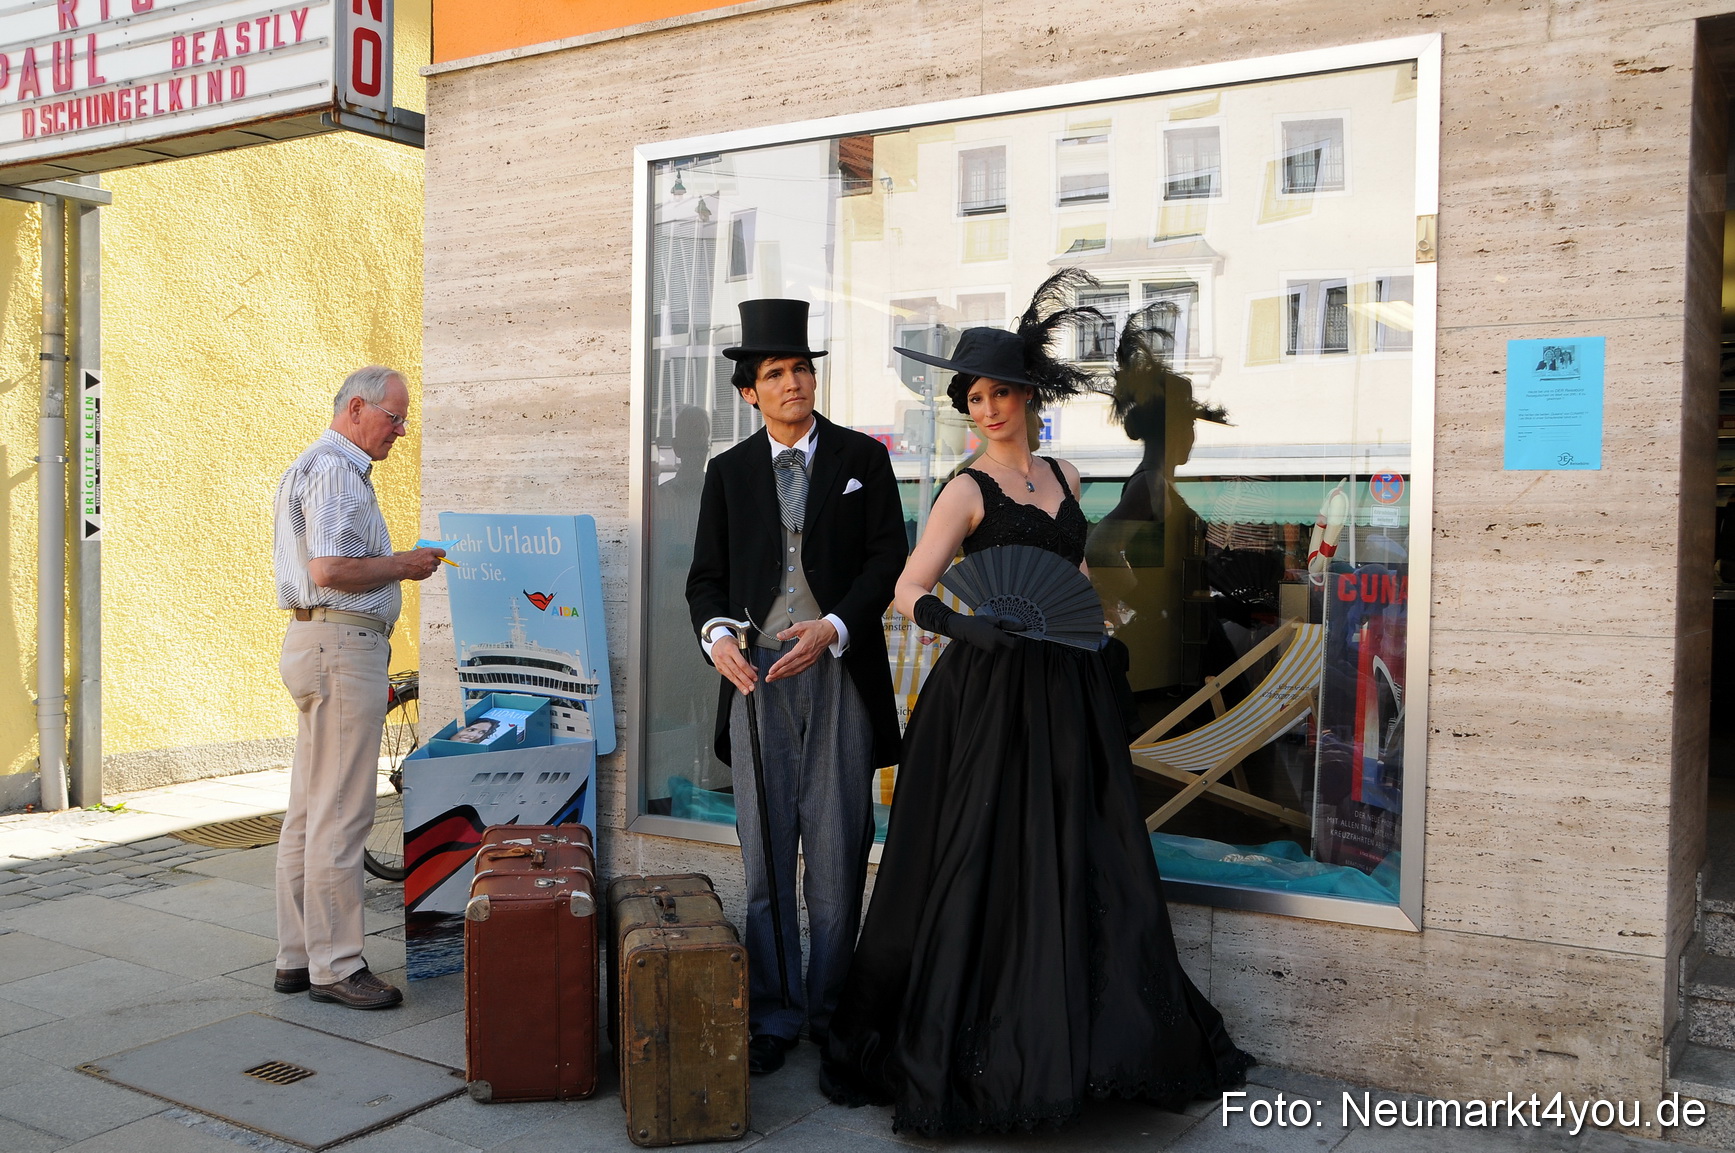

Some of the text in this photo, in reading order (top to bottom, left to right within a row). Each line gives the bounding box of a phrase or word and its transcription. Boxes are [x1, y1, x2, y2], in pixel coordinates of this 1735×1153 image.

[171, 7, 309, 69] BEASTLY
[22, 65, 246, 139] DSCHUNGELKIND
[85, 396, 94, 439] KLEIN
[486, 526, 562, 555] Urlaub
[456, 561, 507, 582] für Sie.
[551, 606, 580, 617] AIDA
[884, 622, 912, 631] önsten
[1326, 816, 1339, 824] MIT
[1341, 820, 1360, 830] ALLEN
[1354, 810, 1367, 820] DER
[1330, 829, 1375, 847] KREUZFAHRTEN
